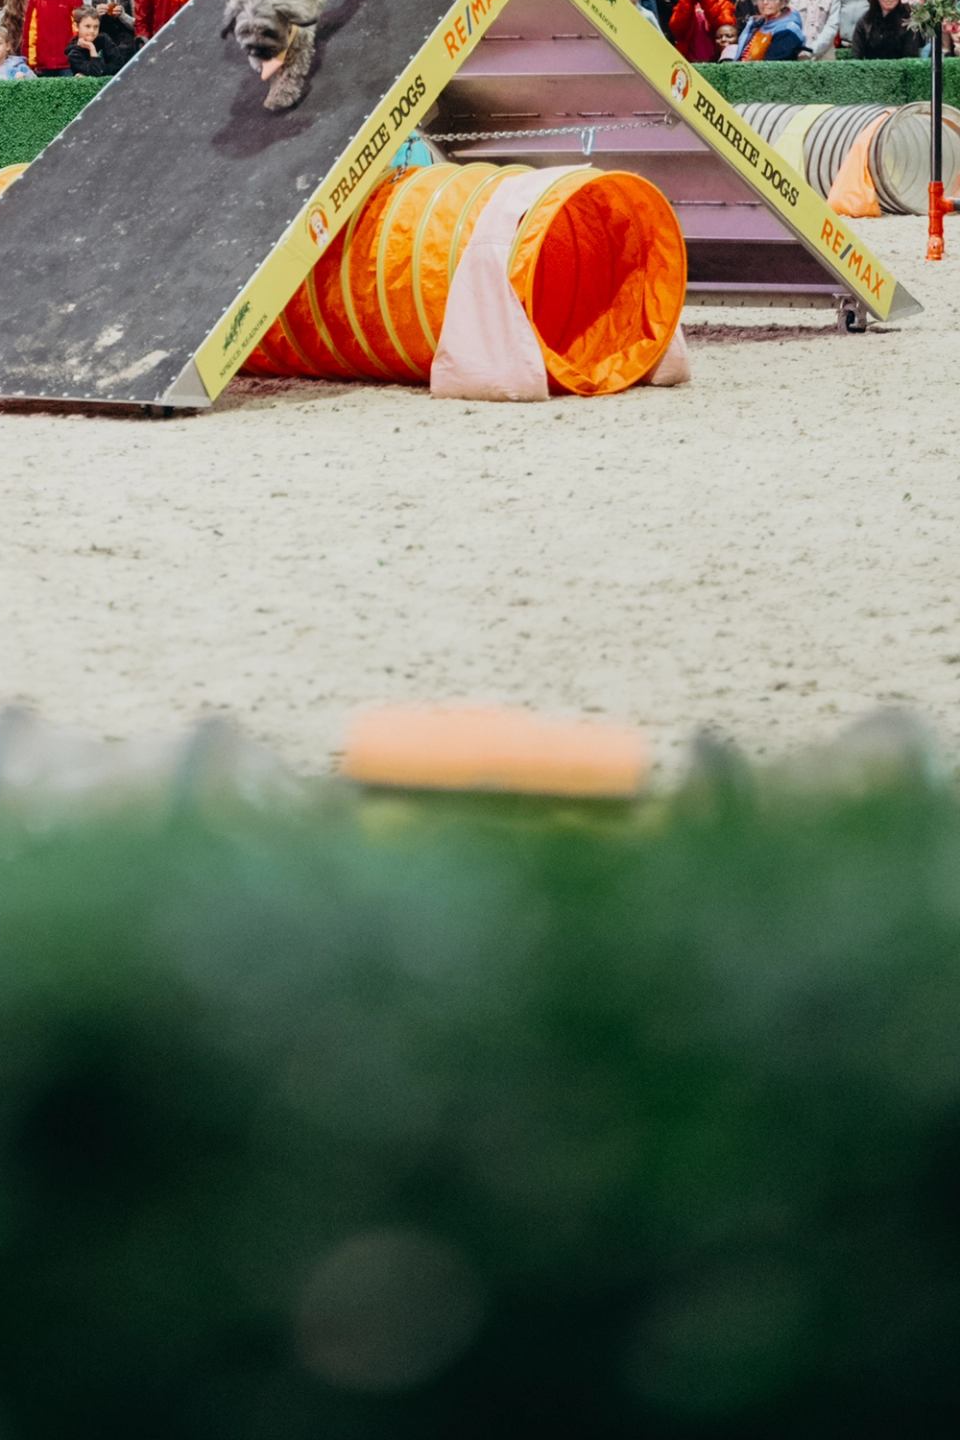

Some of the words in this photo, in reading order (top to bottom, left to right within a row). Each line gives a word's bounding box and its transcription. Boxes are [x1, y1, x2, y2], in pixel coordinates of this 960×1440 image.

[329, 123, 391, 213] PRAIRIE
[389, 74, 427, 131] DOGS
[693, 91, 760, 168] PRAIRIE
[761, 158, 800, 207] DOGS
[820, 218, 884, 299] RE/MAX
